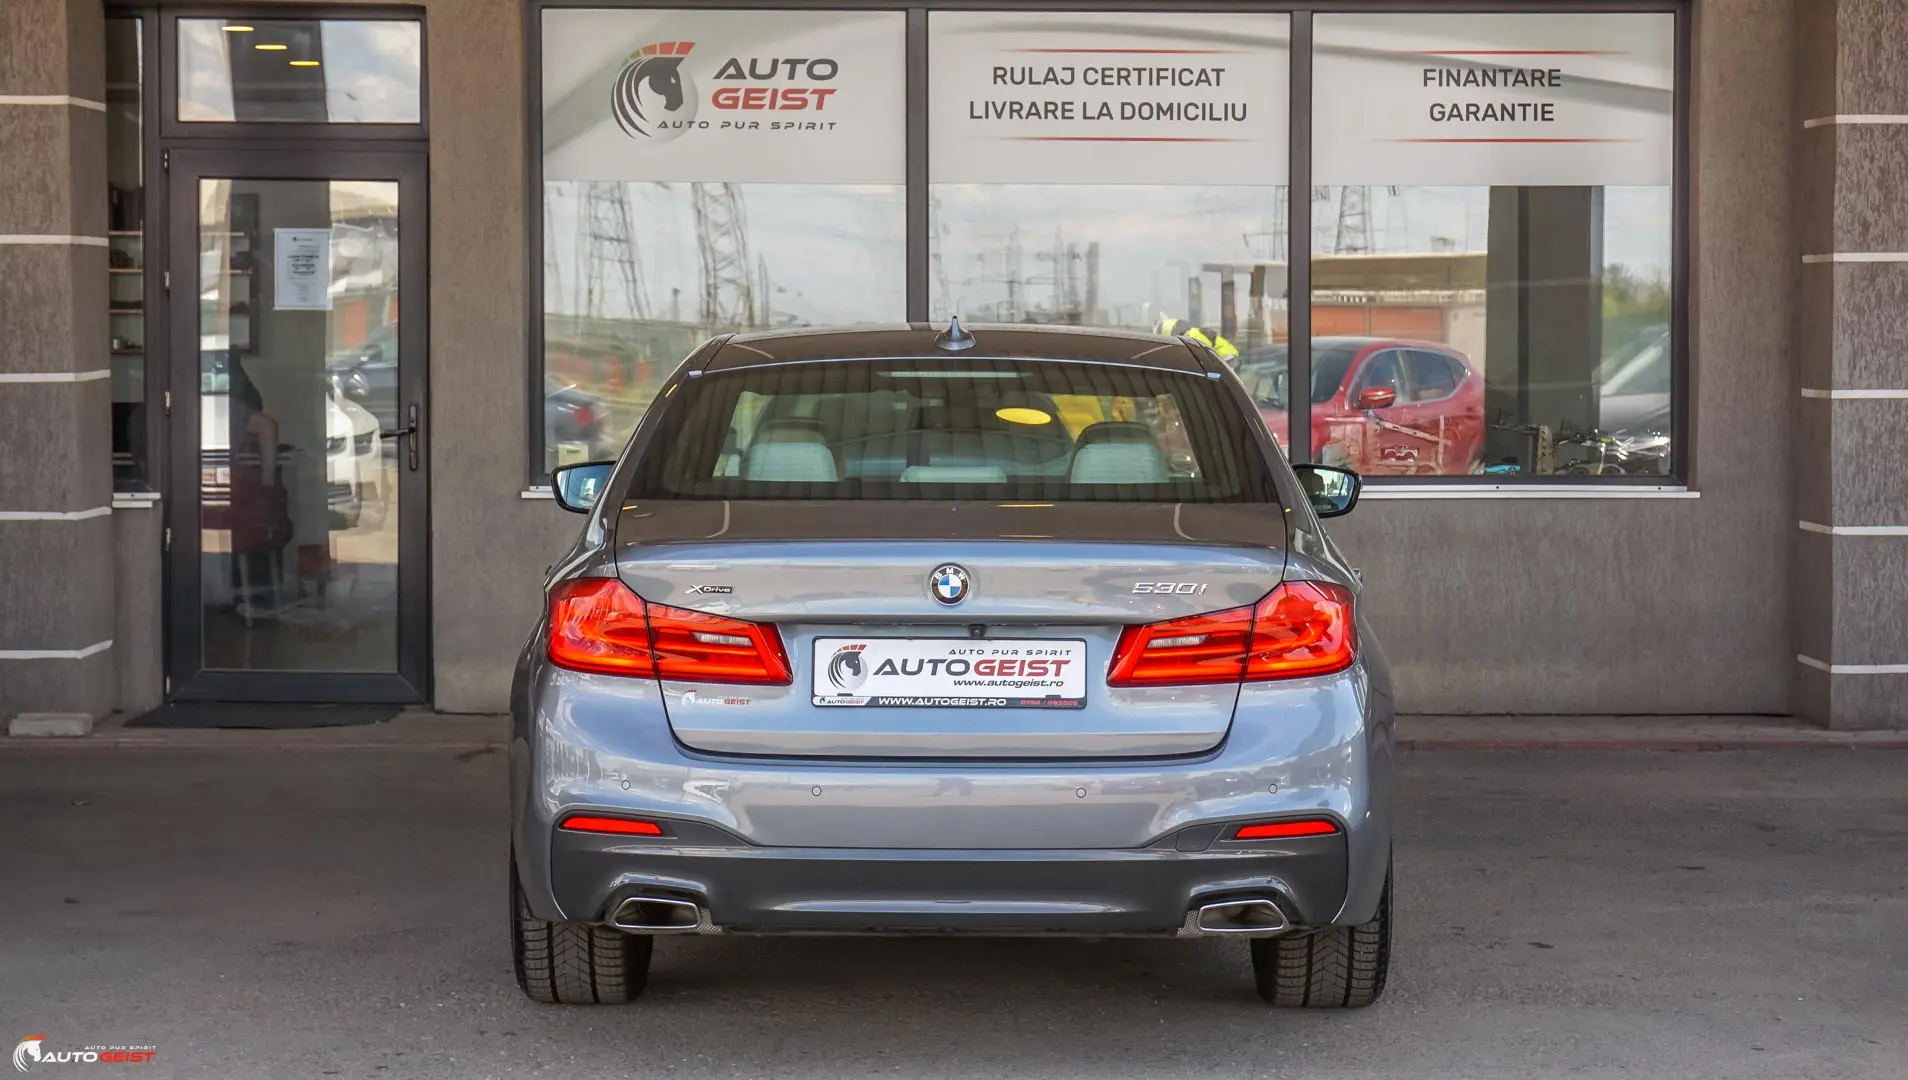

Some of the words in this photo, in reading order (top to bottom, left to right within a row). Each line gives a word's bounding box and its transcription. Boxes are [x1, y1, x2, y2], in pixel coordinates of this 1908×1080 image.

[712, 57, 839, 81] AUTO
[992, 66, 1076, 86] RULAJ
[1082, 66, 1226, 87] CERTIFICAT
[1423, 68, 1562, 88] FINANTARE
[711, 87, 838, 111] GEIST
[968, 100, 1075, 120] LIVRARE
[1082, 101, 1114, 120] LA
[1120, 101, 1248, 121] DOMICILIU
[1429, 102, 1555, 122] GARANTIE
[657, 120, 710, 130] AUTO
[720, 121, 760, 130] PUR
[769, 121, 838, 131] SPIRIT
[953, 679, 1064, 689] www.autogeist.ro
[878, 696, 1007, 706] WWW.AUTOGEIST.RO
